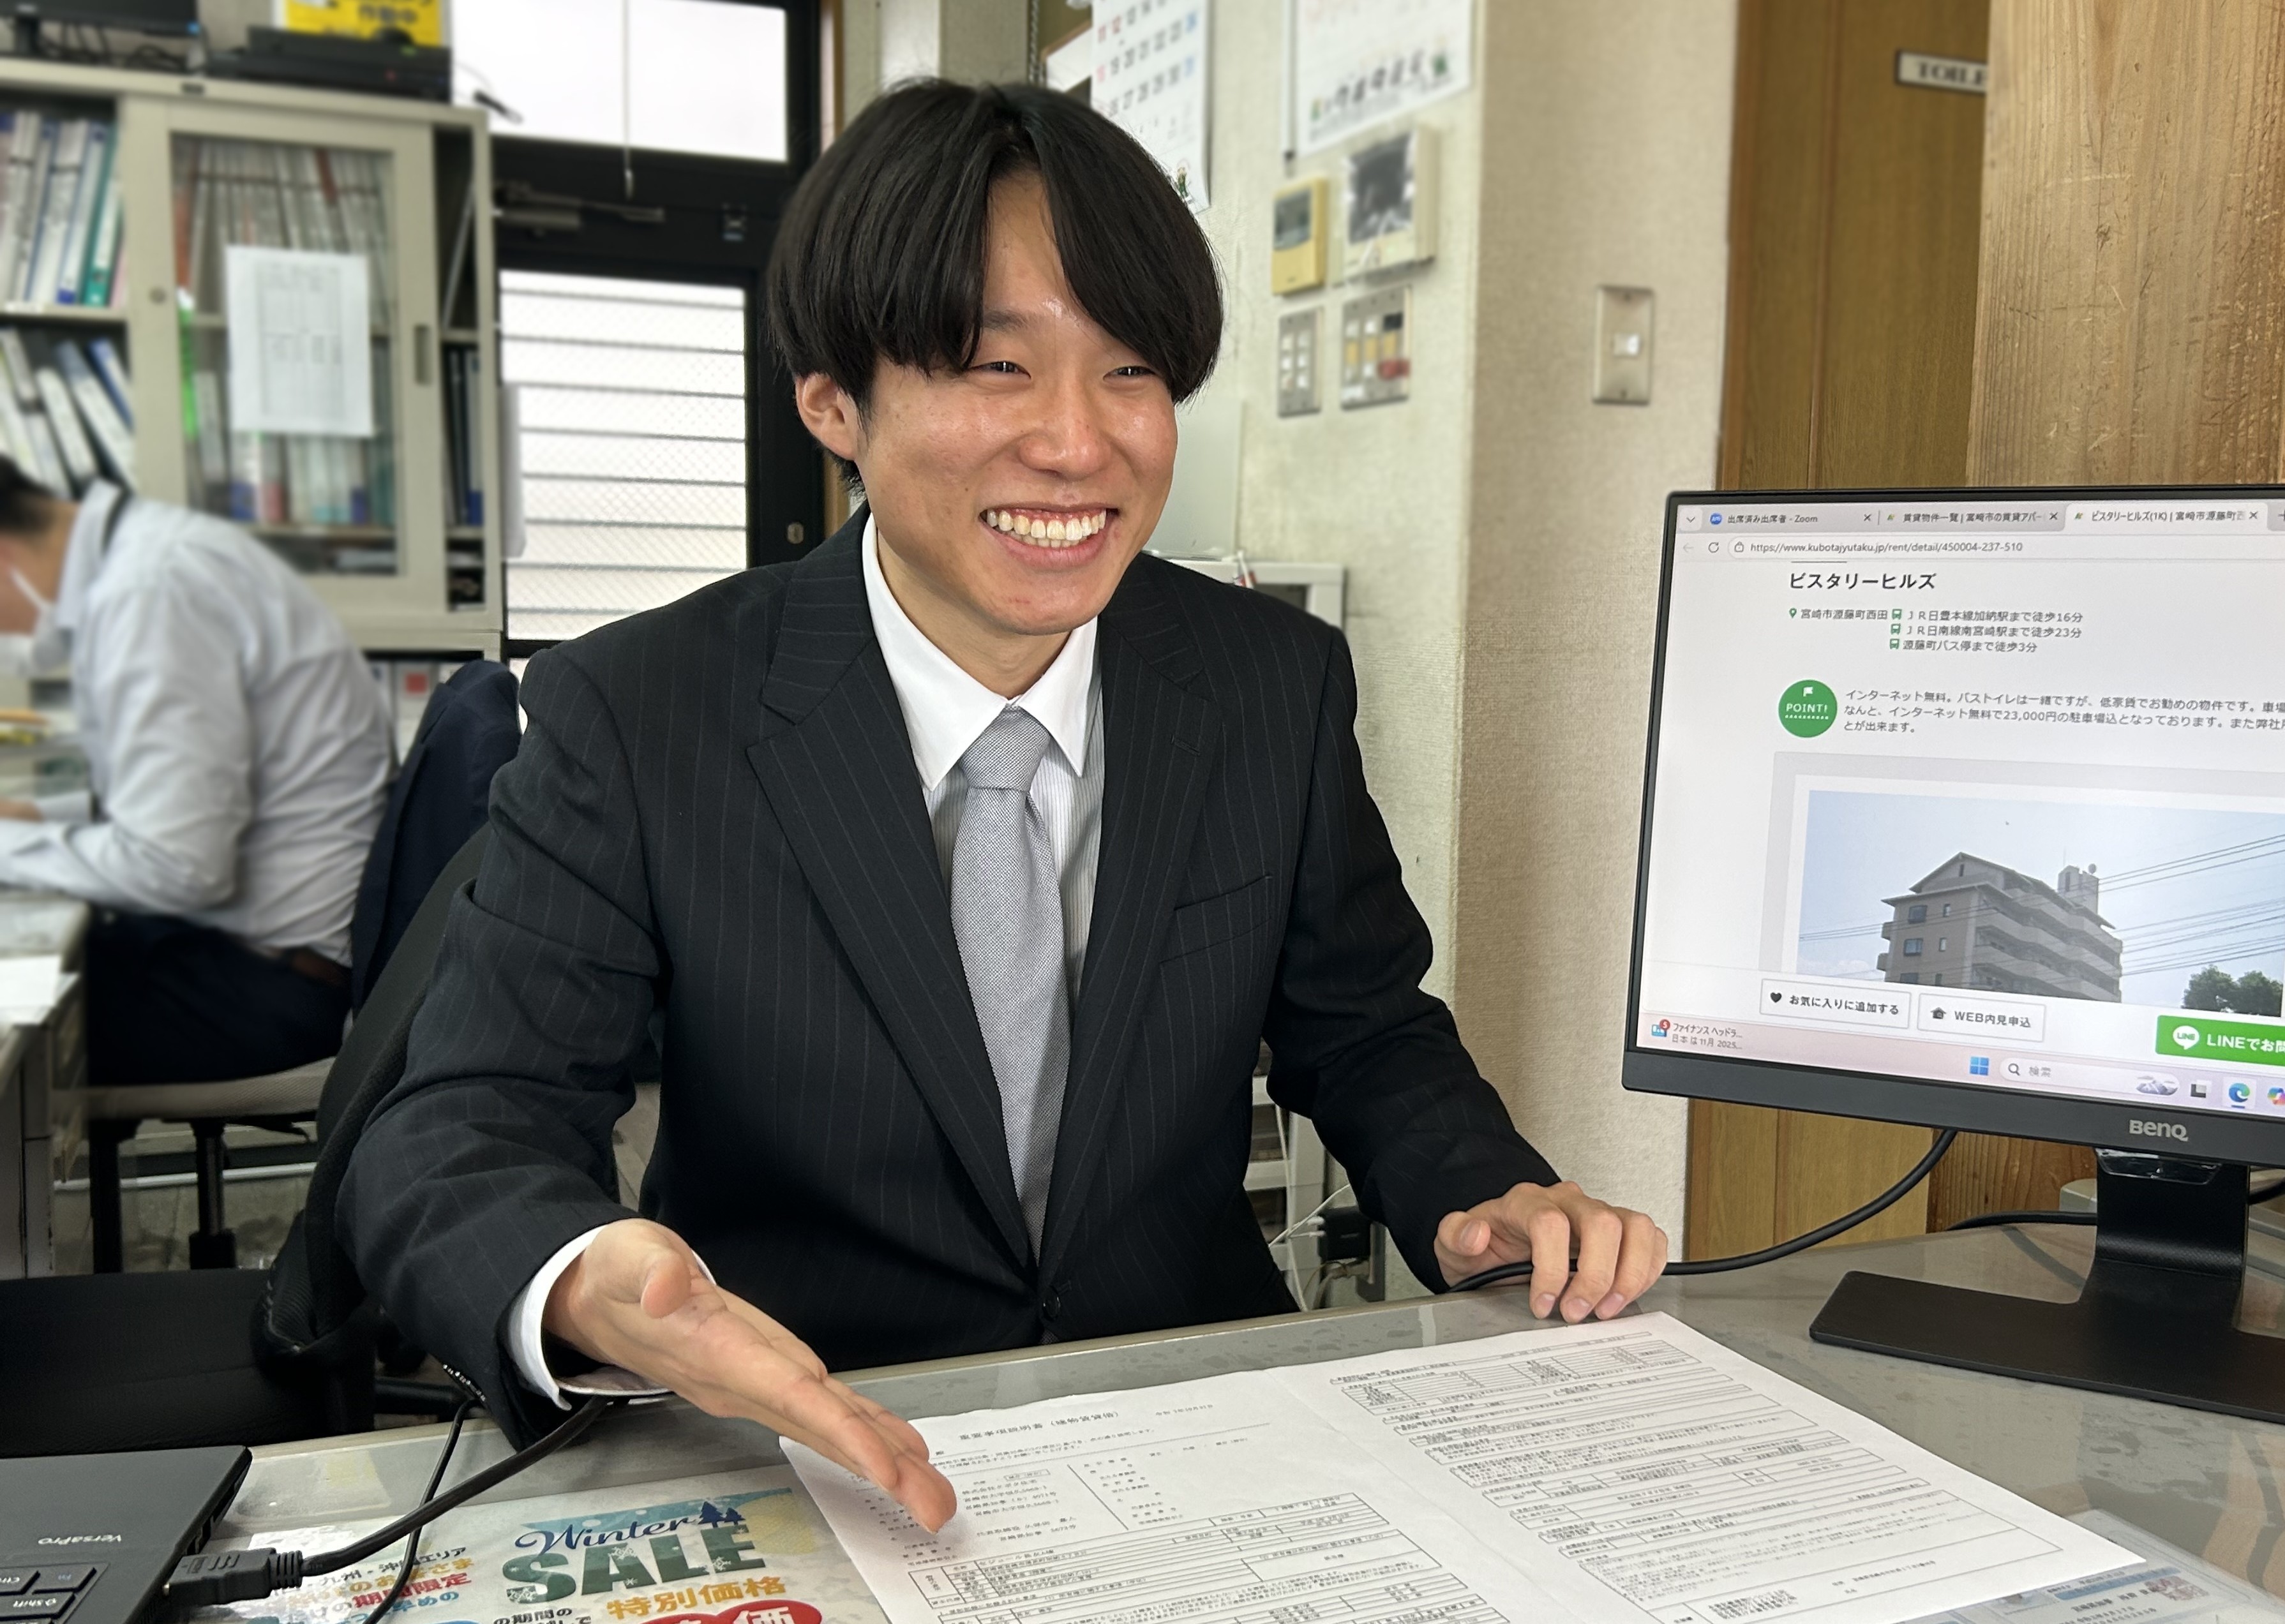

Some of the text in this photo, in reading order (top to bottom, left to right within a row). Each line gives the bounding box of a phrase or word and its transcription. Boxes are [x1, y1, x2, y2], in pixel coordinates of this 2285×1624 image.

[1794, 514, 1818, 523] Zoom
[1750, 542, 2023, 555] https://www.kubotajyutaku.jp/rent/detail/450004-237-510
[1790, 572, 1937, 590] ビスタリーヒルズ
[1801, 608, 1888, 620] 宮崎市源藤町西田
[1903, 639, 2037, 653] 源藤町バス停まで徒歩3分
[1785, 703, 1828, 713] POINT!
[1844, 720, 1915, 734] とが出来ます。
[1788, 994, 1899, 1015] お気に入りに追加する
[1954, 1010, 2031, 1029] WEB内見申込
[1673, 1022, 1710, 1035] ファイナンス
[2176, 1032, 2196, 1041] LINE
[2129, 1119, 2189, 1142] BenQ
[514, 1516, 700, 1556] Winter
[502, 1524, 766, 1604] SALE
[607, 1576, 786, 1620] 特別価格
